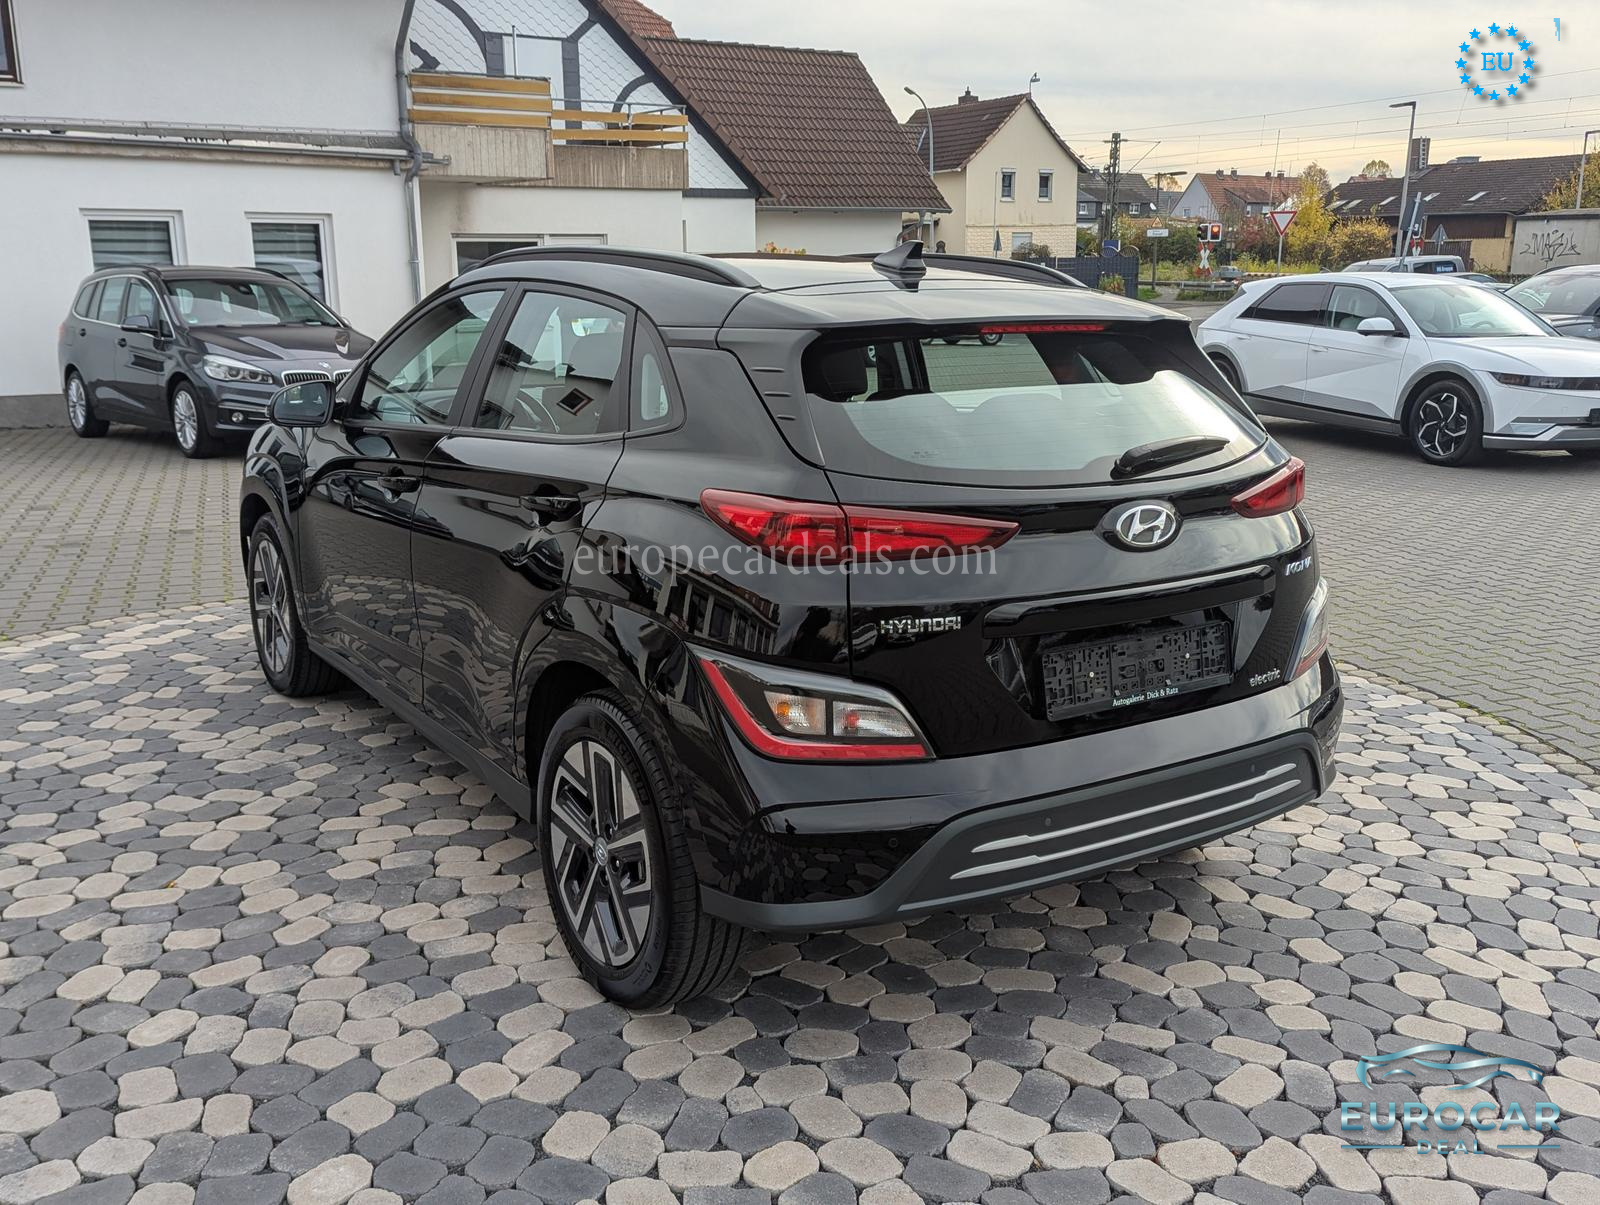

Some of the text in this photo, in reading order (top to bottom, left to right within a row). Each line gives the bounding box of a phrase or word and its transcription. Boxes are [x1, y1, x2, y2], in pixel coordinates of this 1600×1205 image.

[880, 616, 961, 634] HYUNDAI
[1250, 667, 1280, 687] electric
[1112, 694, 1145, 707] Autogalerie
[1146, 690, 1160, 700] Dick
